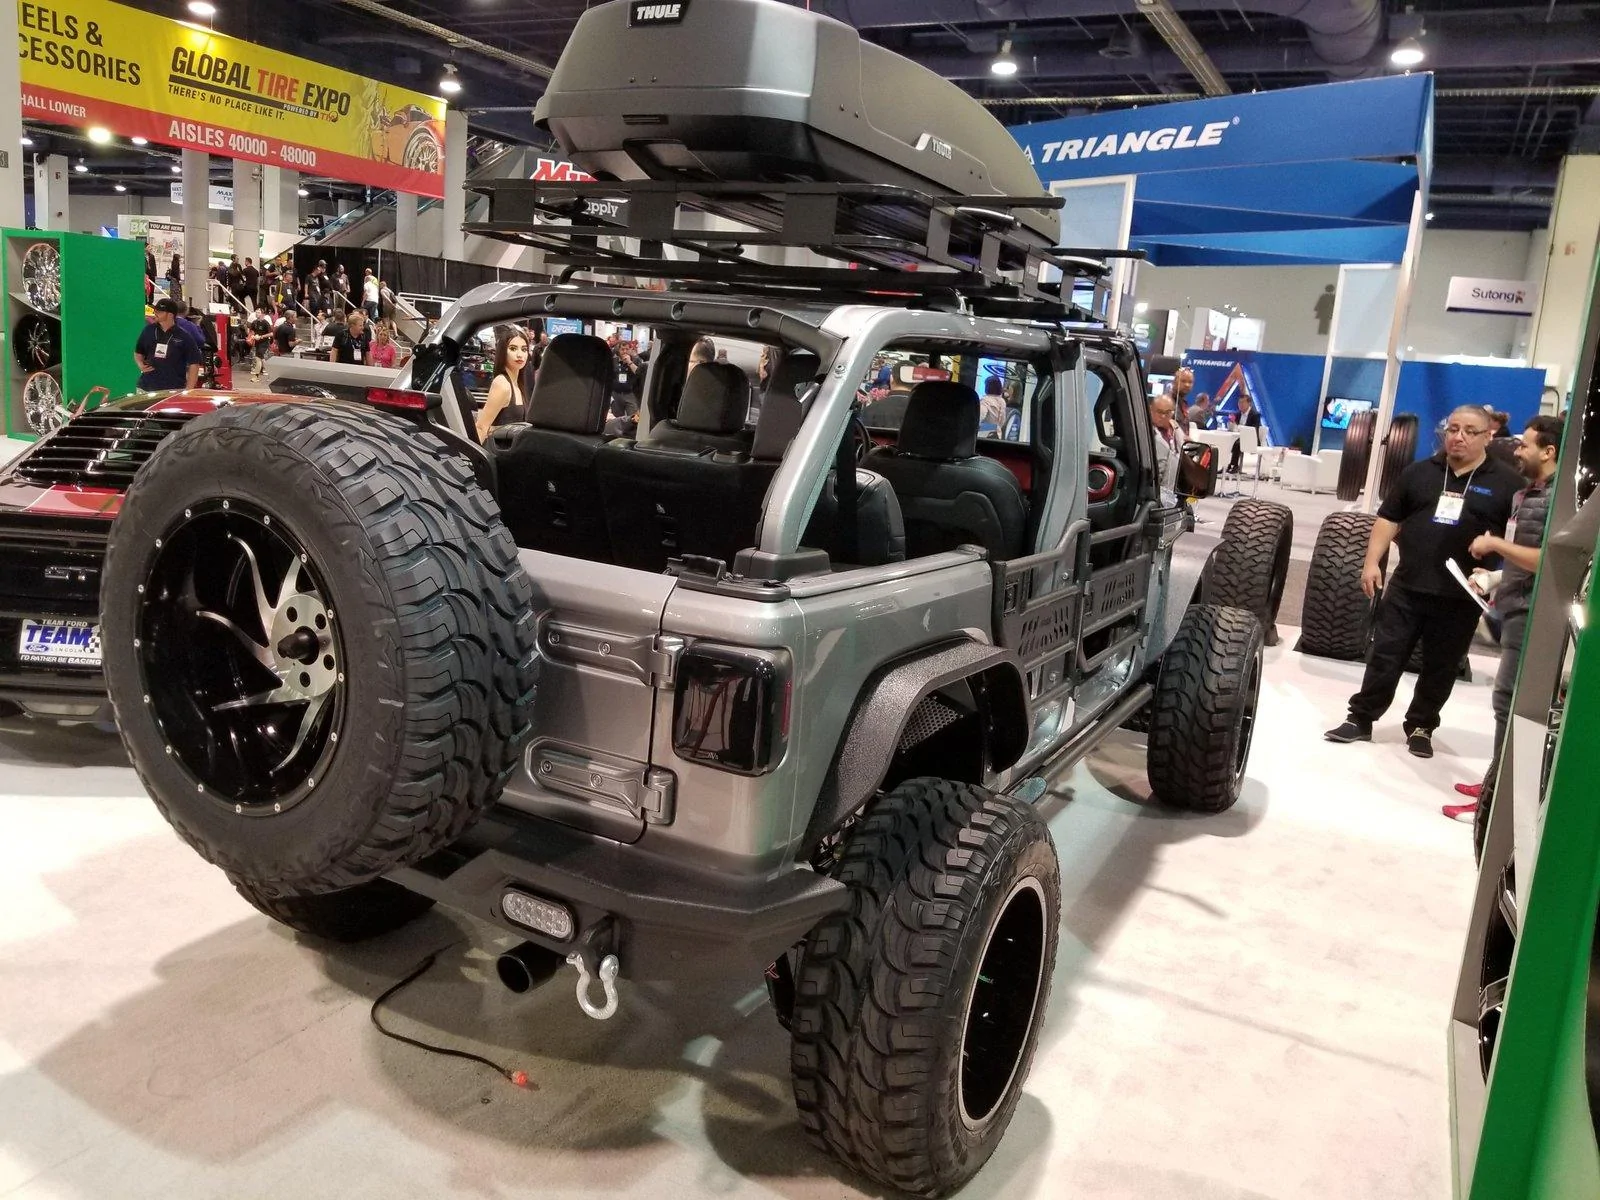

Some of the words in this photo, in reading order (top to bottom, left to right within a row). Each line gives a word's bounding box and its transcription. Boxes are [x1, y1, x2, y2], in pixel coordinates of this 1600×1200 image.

[20, 2, 79, 40] EELS
[86, 21, 103, 47] &
[636, 4, 681, 20] THULE
[19, 33, 141, 85] CESSORIES
[171, 46, 251, 91] GLOBAL
[257, 68, 299, 102] TIRE
[302, 82, 351, 116] EXPO
[21, 94, 46, 109] HALL
[49, 100, 86, 117] LOWER
[168, 84, 206, 101] THERE'S
[209, 94, 222, 105] NO
[224, 98, 252, 112] PLACE
[255, 105, 273, 118] LIKE
[275, 109, 285, 121] IT.
[283, 103, 309, 115] POWERED
[169, 120, 224, 148] AISLES
[228, 133, 268, 157] 40000
[280, 144, 317, 167] 48000
[1041, 120, 1230, 164] TRIANGLE
[1471, 287, 1515, 303] Sutong
[1193, 359, 1233, 367] TRIANGLE
[26, 624, 93, 647] TEAM
